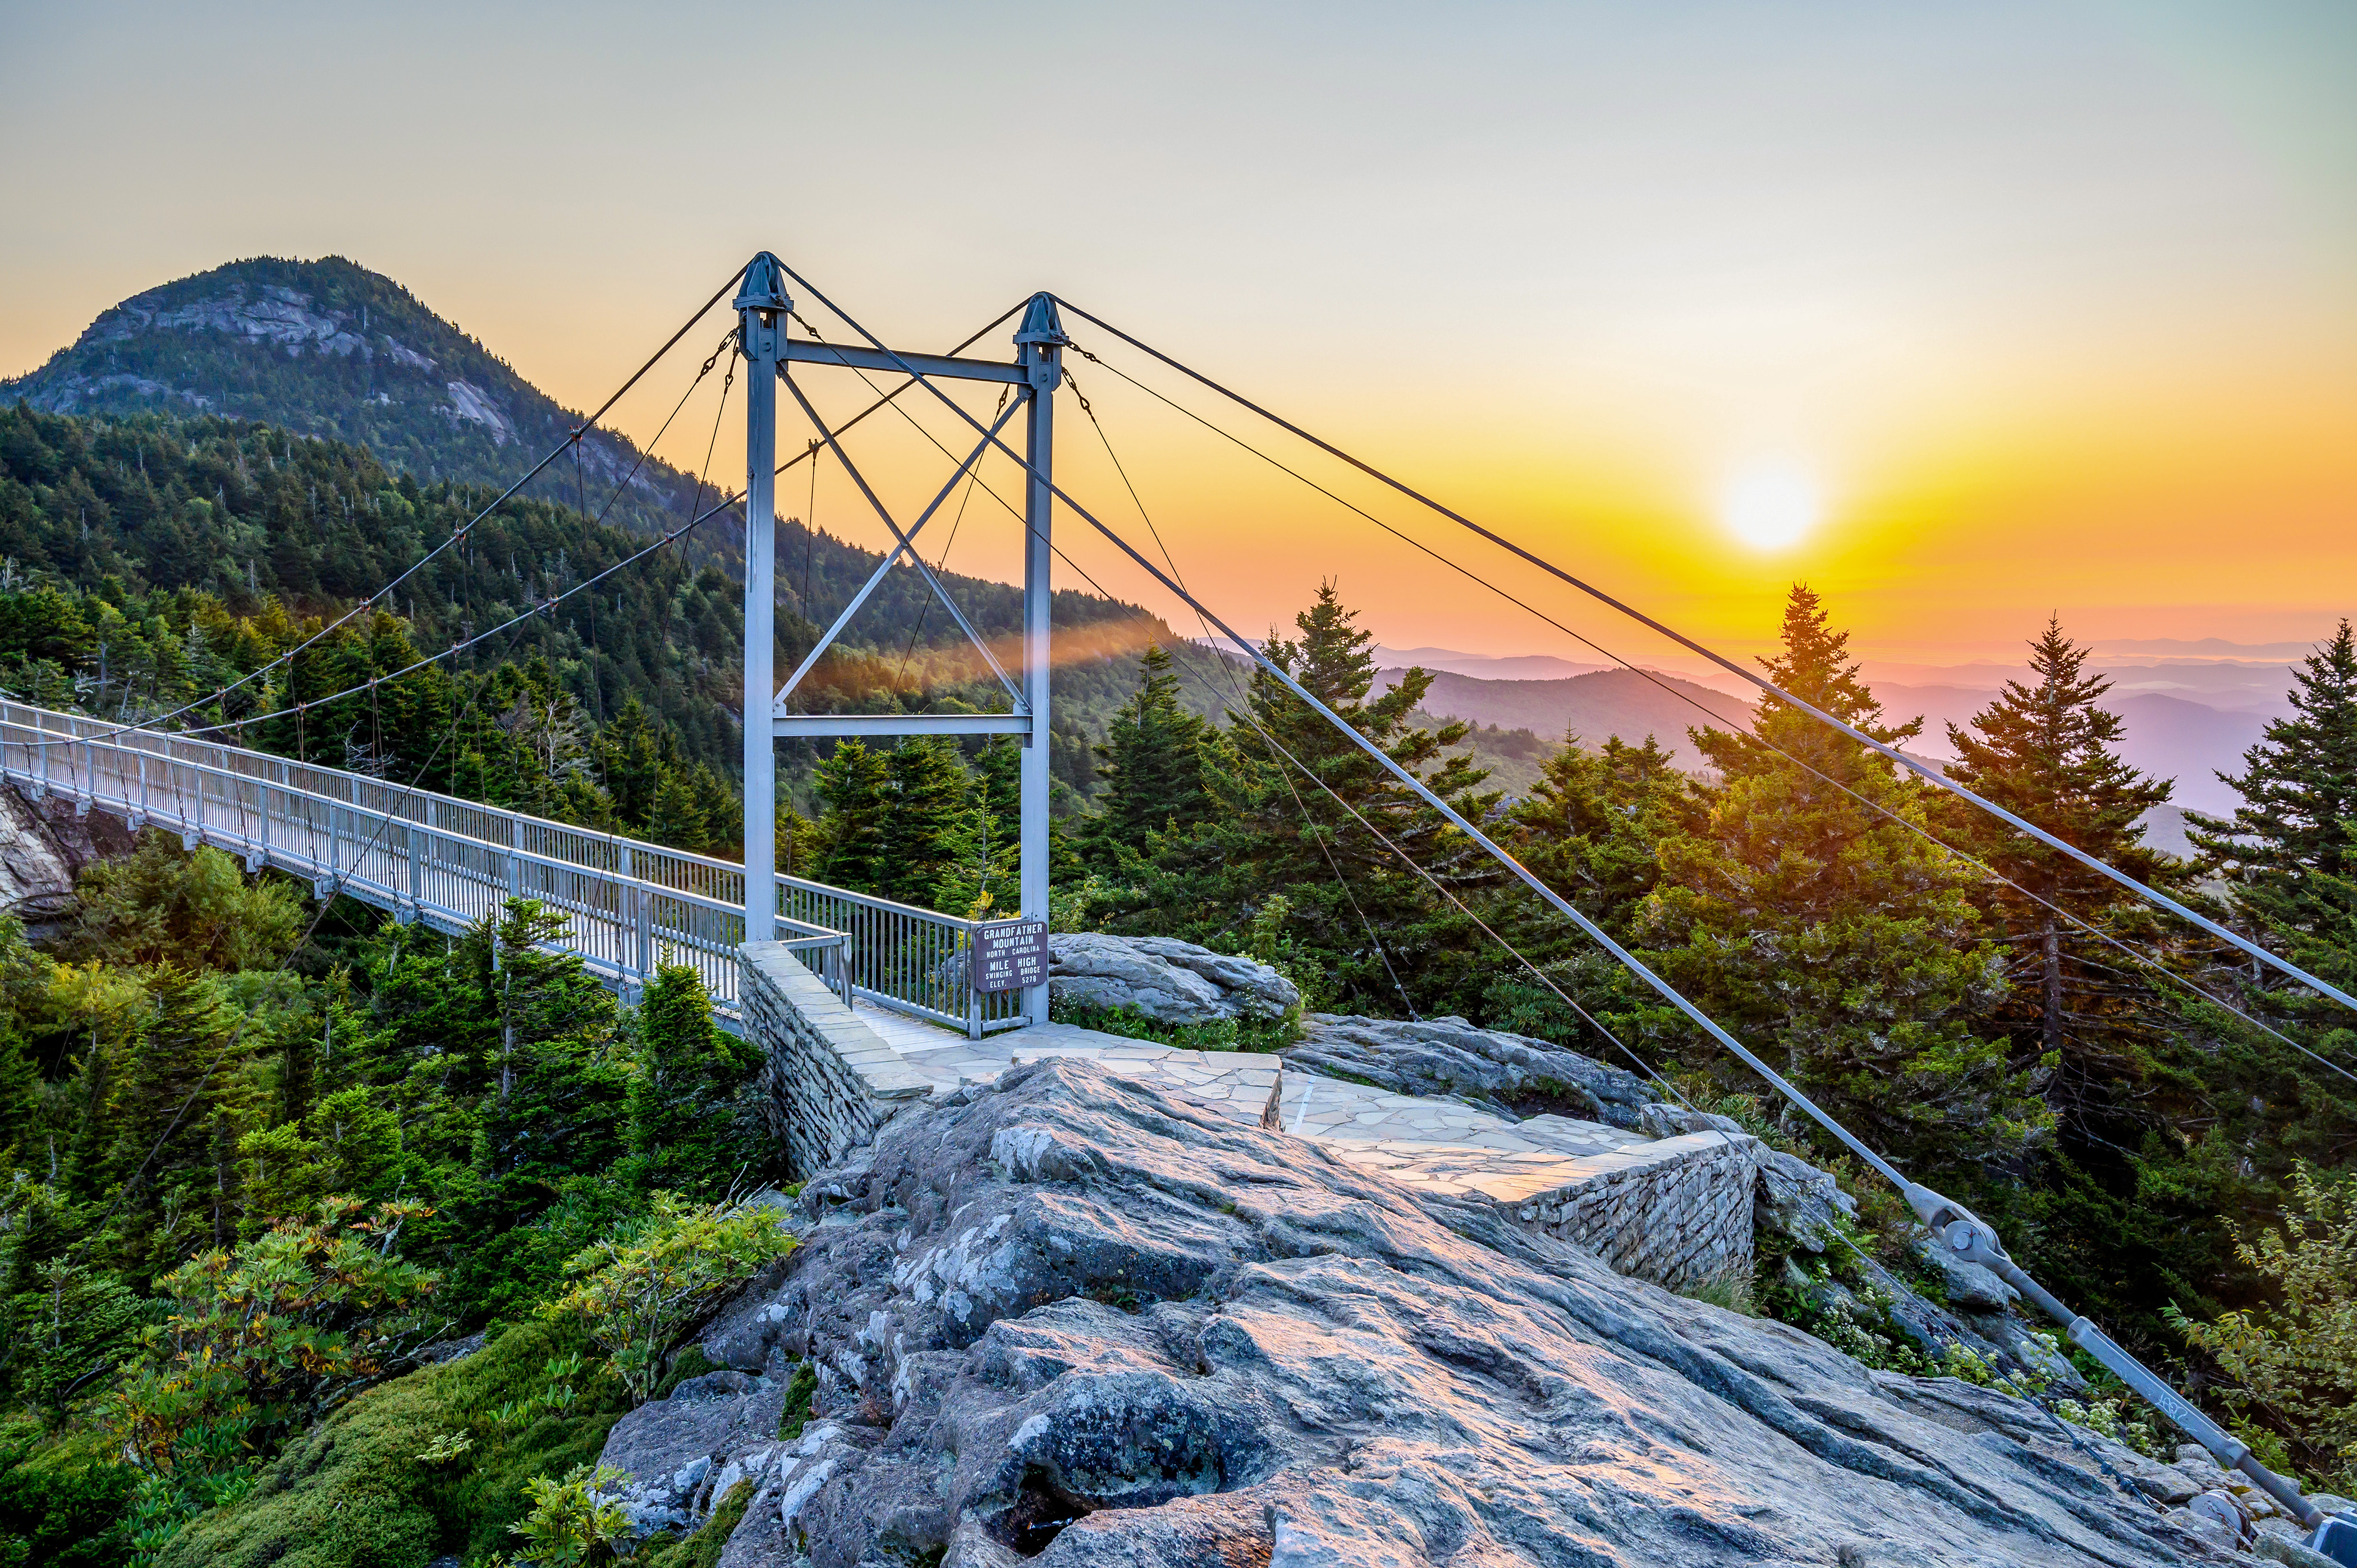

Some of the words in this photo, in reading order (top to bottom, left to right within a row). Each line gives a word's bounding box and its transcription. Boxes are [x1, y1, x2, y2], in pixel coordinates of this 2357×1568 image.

[984, 923, 1042, 940] GRANDFATHER
[993, 935, 1034, 949] MOUNTAIN
[987, 950, 1005, 958] NORTH
[1012, 945, 1040, 955] CAROLINA
[990, 960, 1009, 971] MILE
[1017, 956, 1036, 968] HIGH
[985, 970, 1012, 980] SWINGING
[1020, 966, 1040, 975] BRIDGE
[990, 980, 1007, 988] ELEV.
